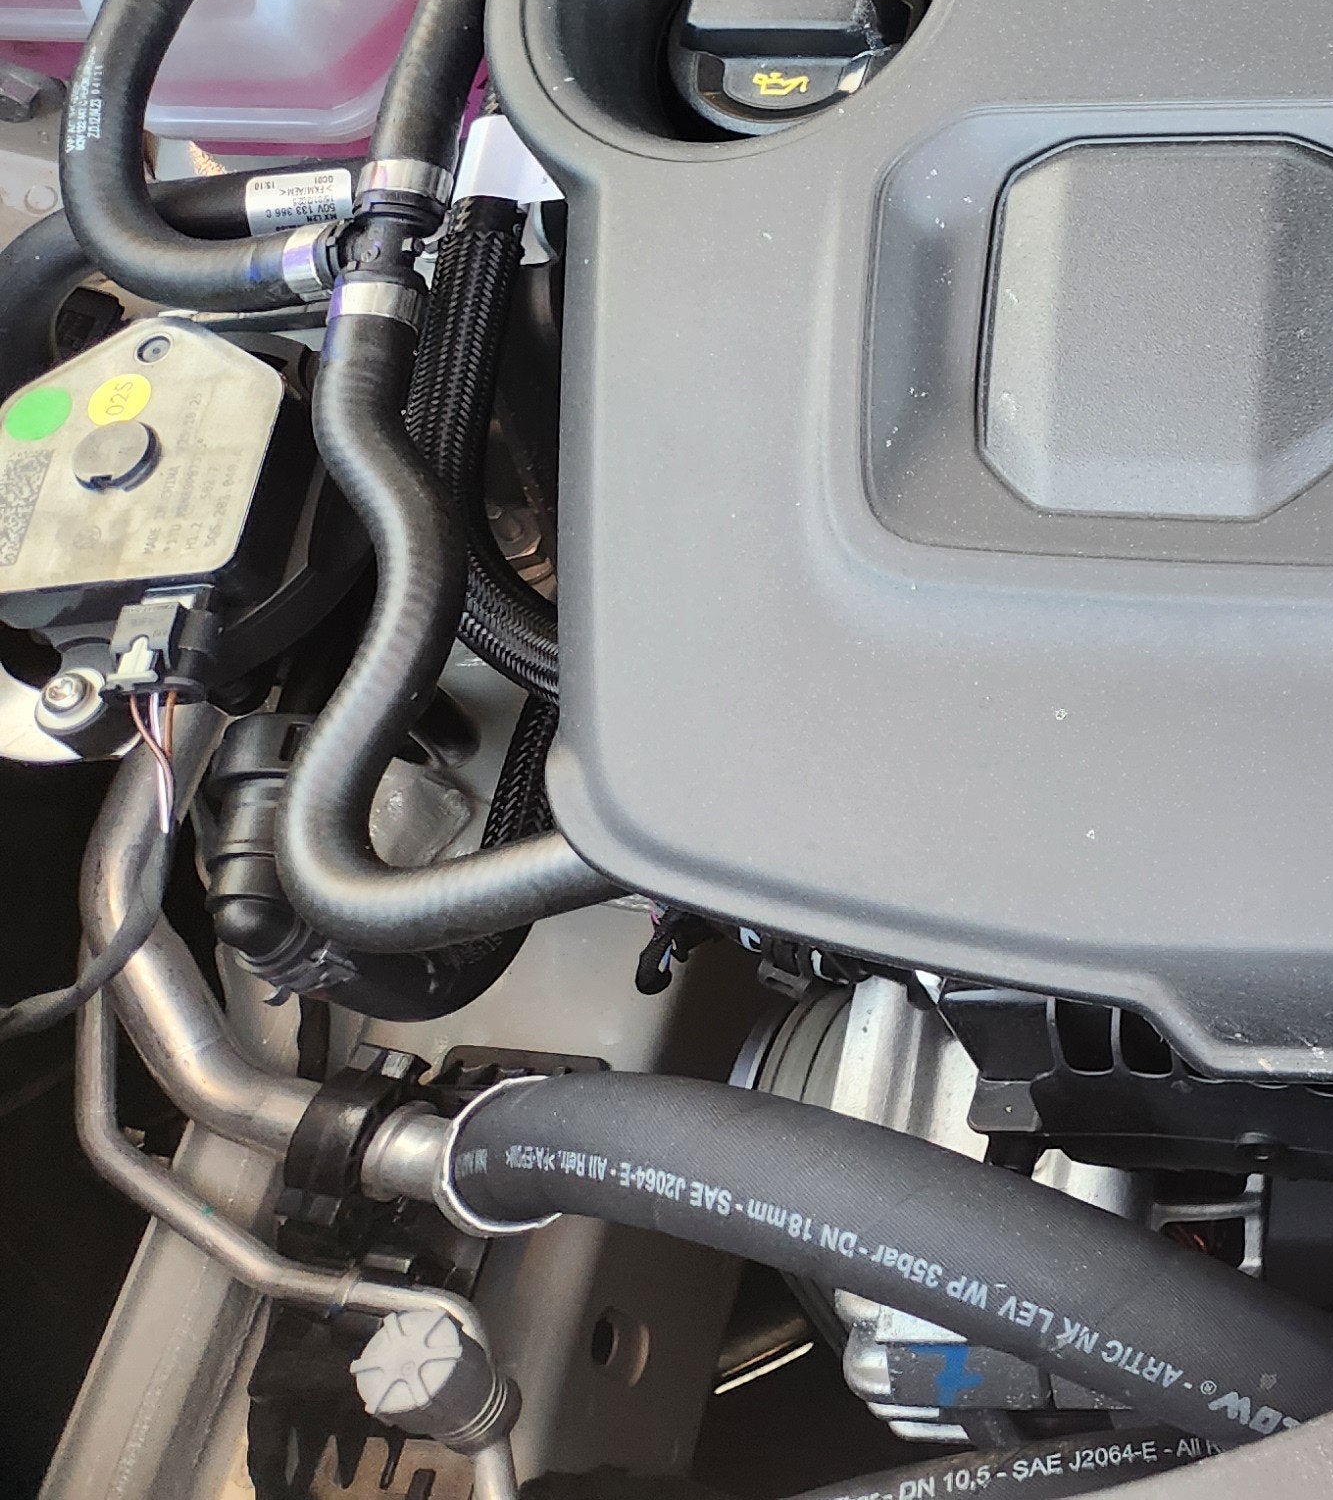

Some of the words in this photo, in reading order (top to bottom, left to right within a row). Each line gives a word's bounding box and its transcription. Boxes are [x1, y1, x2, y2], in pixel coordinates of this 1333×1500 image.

[620, 1162, 685, 1200] J2064-E
[690, 1181, 732, 1216] SAE
[820, 1223, 858, 1258] DN
[871, 1244, 943, 1289] 35bar
[946, 1275, 988, 1309] WP
[1056, 1317, 1099, 1354] NK
[1102, 1339, 1184, 1388] ARTIC
[1012, 1452, 1063, 1482] SAE
[1069, 1440, 1158, 1473] J2064-E
